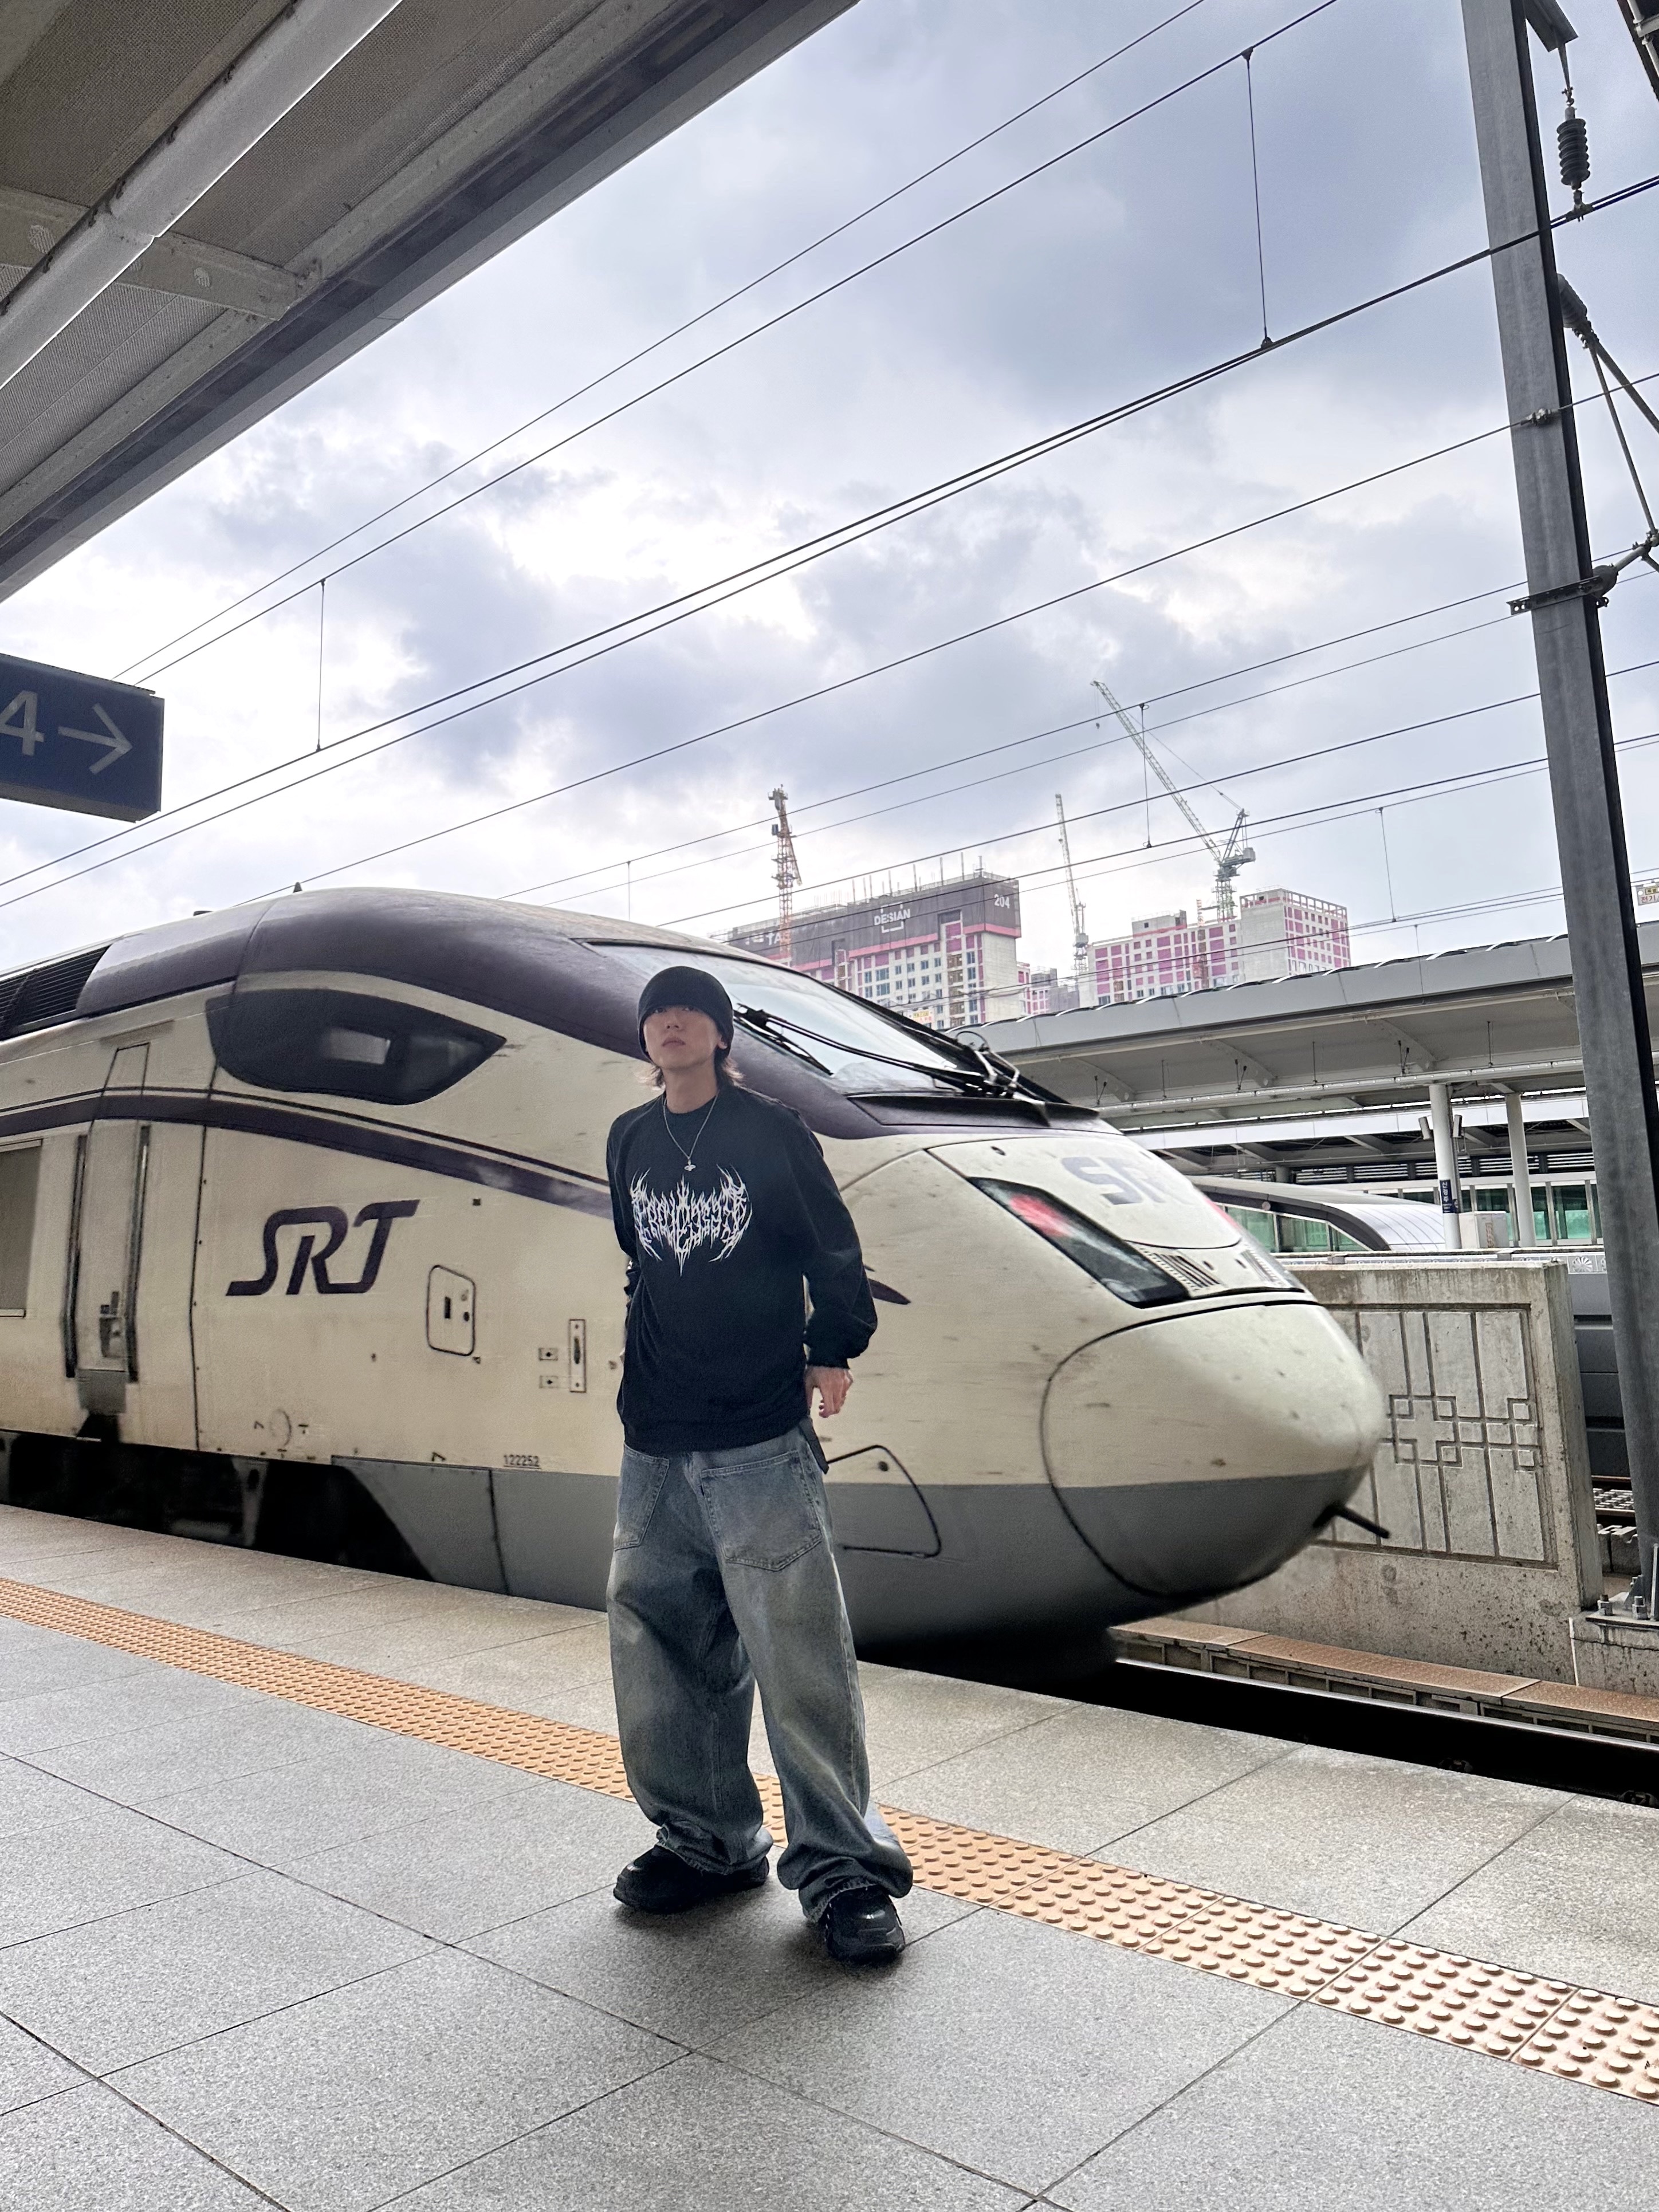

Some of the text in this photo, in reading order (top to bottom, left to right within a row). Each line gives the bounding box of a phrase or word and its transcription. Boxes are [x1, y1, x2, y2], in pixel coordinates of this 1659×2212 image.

[0, 690, 45, 756] 4
[874, 908, 910, 926] DESIAN
[994, 894, 1010, 908] 204
[226, 1199, 420, 1296] SRT
